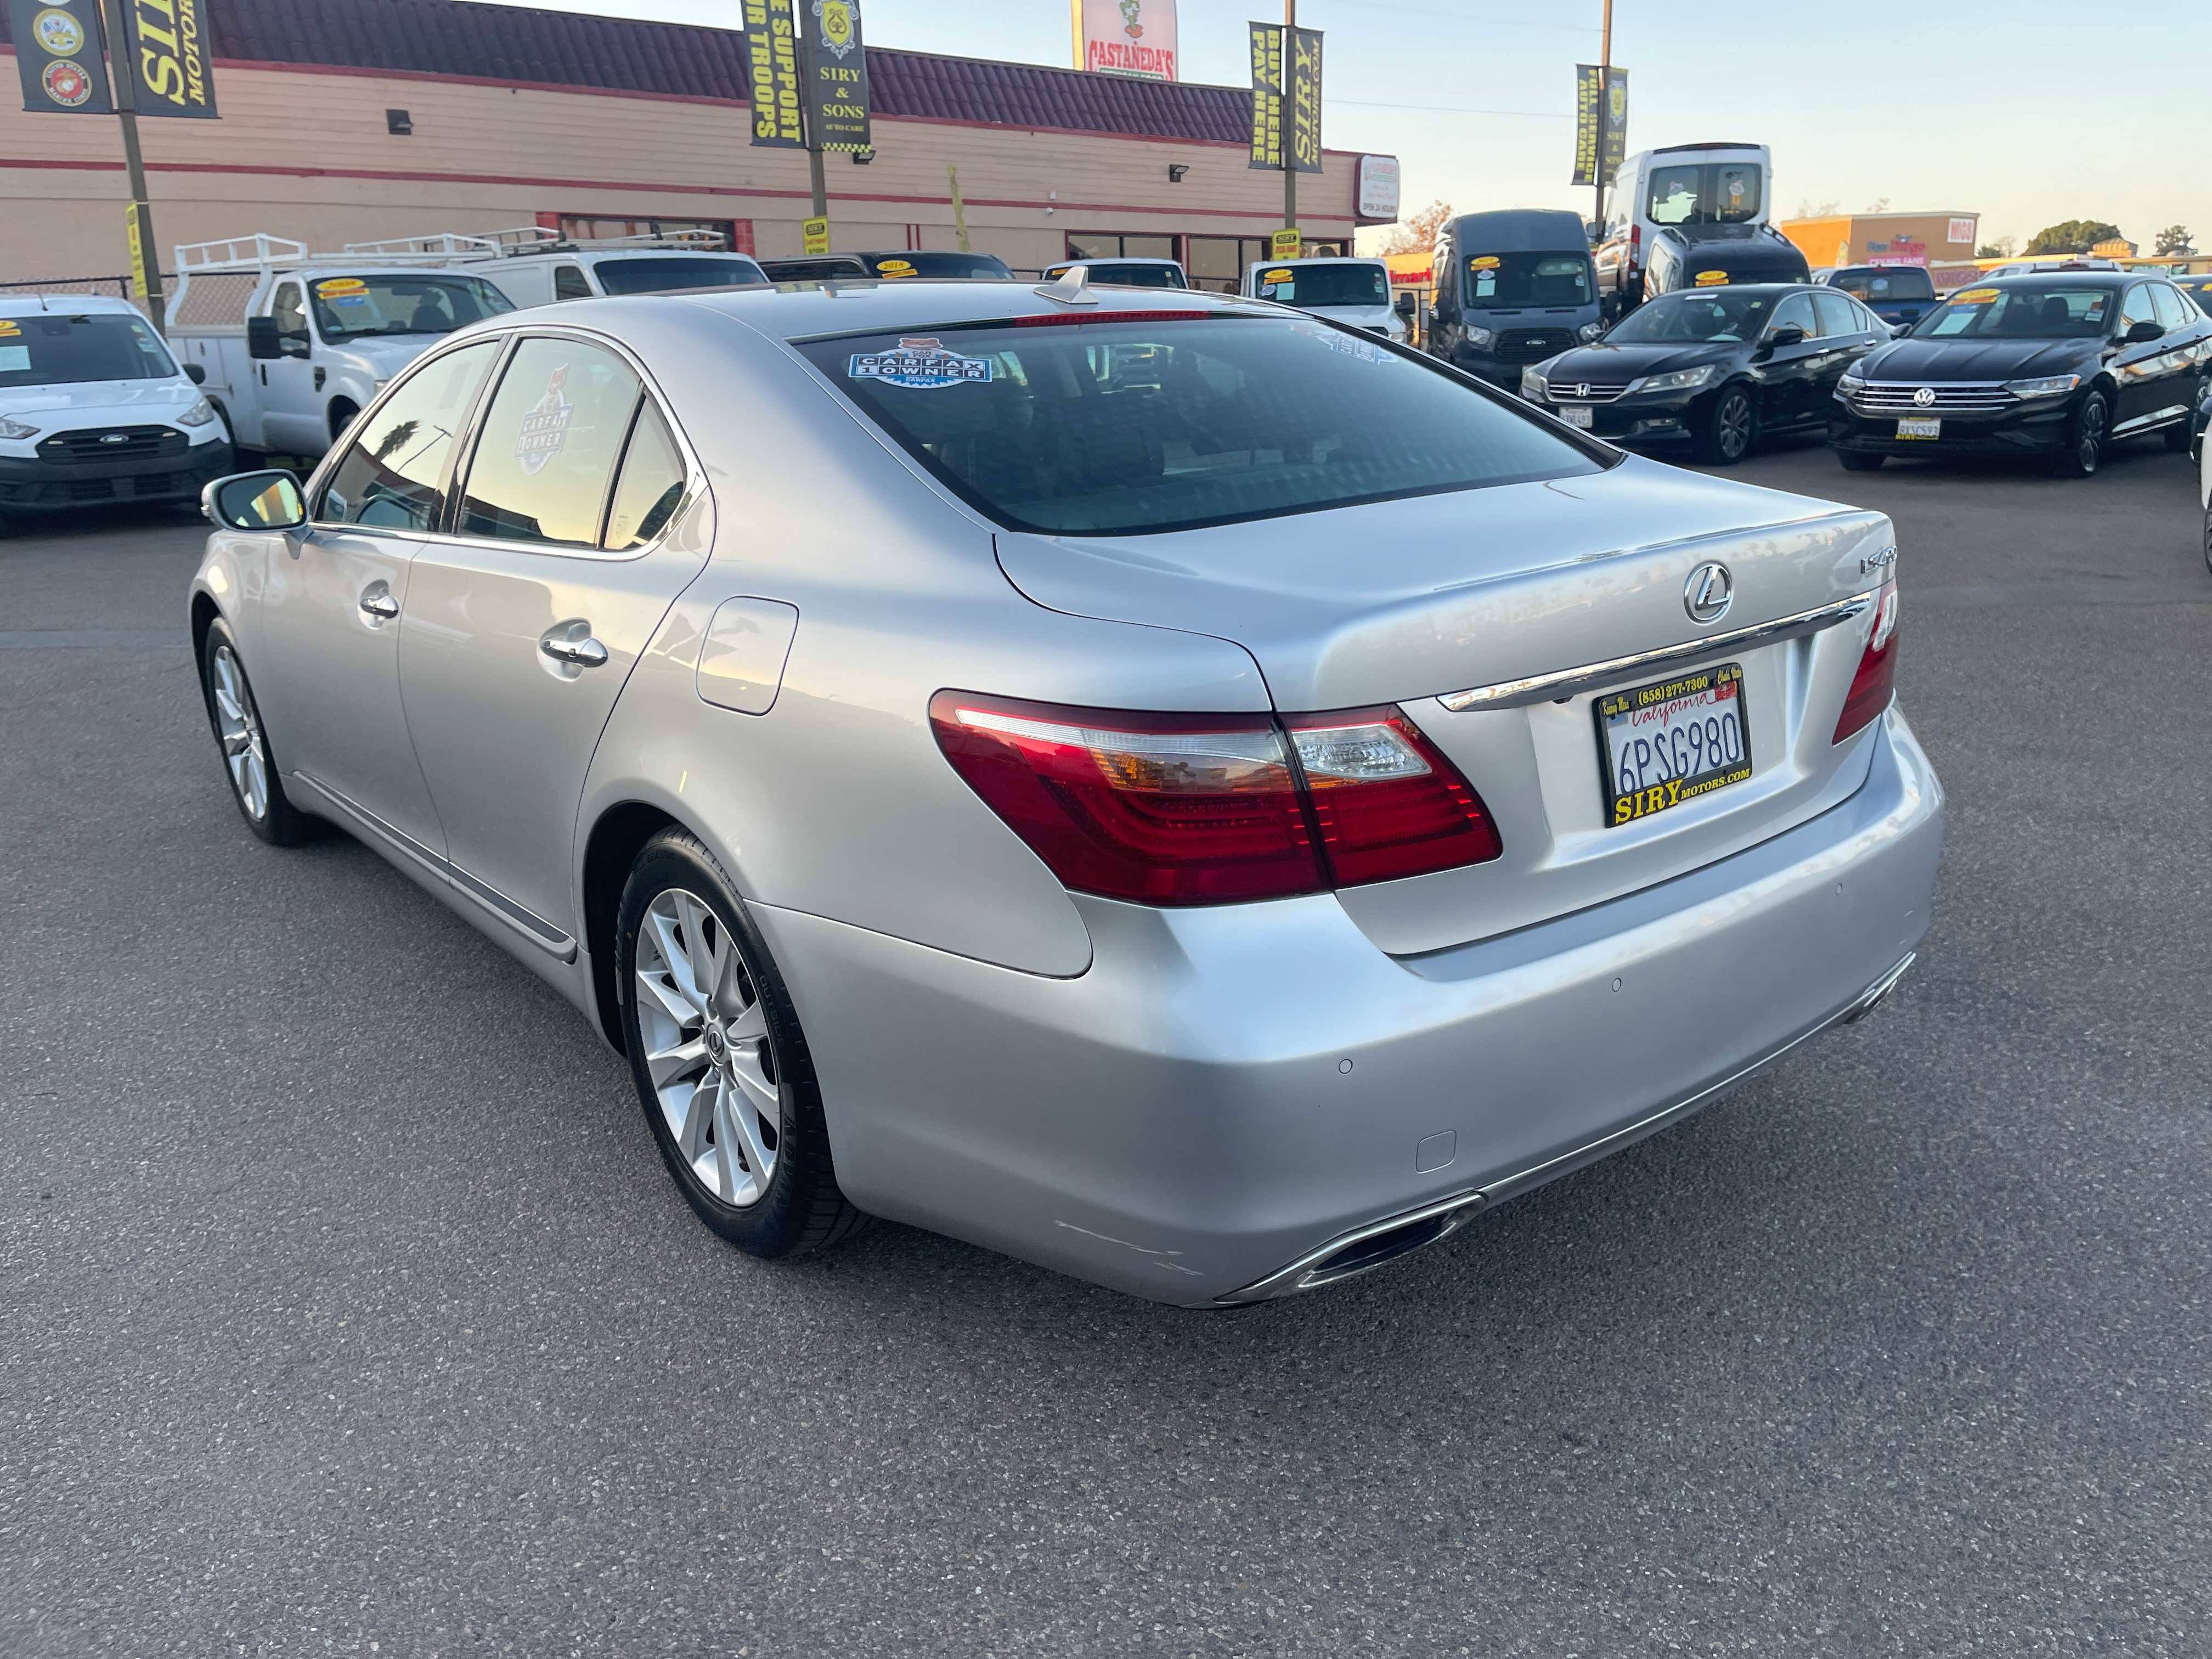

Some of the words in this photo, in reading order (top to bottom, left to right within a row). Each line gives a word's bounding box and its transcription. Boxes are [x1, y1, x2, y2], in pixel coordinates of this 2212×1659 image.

[772, 18, 800, 142] SUPPORT
[820, 66, 861, 82] SIRY
[1252, 31, 1266, 83] PAY
[1267, 30, 1280, 88] BUY
[749, 31, 777, 138] TROOPS
[822, 104, 865, 119] SONS
[836, 87, 849, 99] &
[1295, 34, 1311, 165] SIRY
[1252, 90, 1266, 161] HERE
[1267, 96, 1280, 165] HERE
[862, 358, 980, 369] CARFAX
[882, 367, 980, 377] OWNER
[1633, 692, 1716, 727] California
[1620, 713, 1739, 795] 6PSG980
[1616, 779, 1683, 823] SIRY
[1680, 769, 1750, 799] MOTORS.COM
